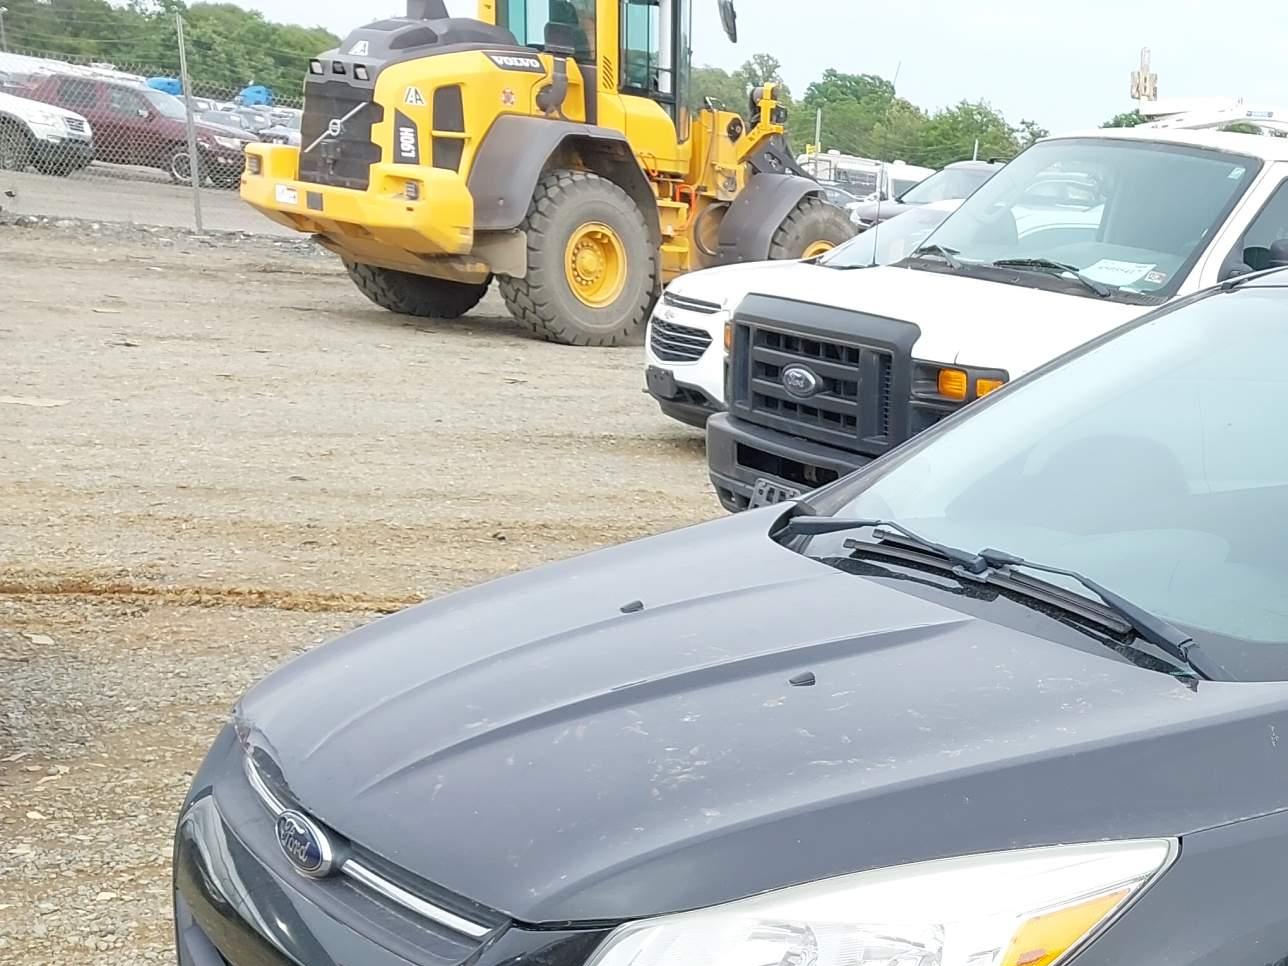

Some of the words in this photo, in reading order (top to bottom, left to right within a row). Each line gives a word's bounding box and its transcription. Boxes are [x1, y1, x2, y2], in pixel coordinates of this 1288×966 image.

[490, 55, 540, 68] VOLVO
[400, 127, 415, 158] L90H
[279, 815, 313, 863] Ford
